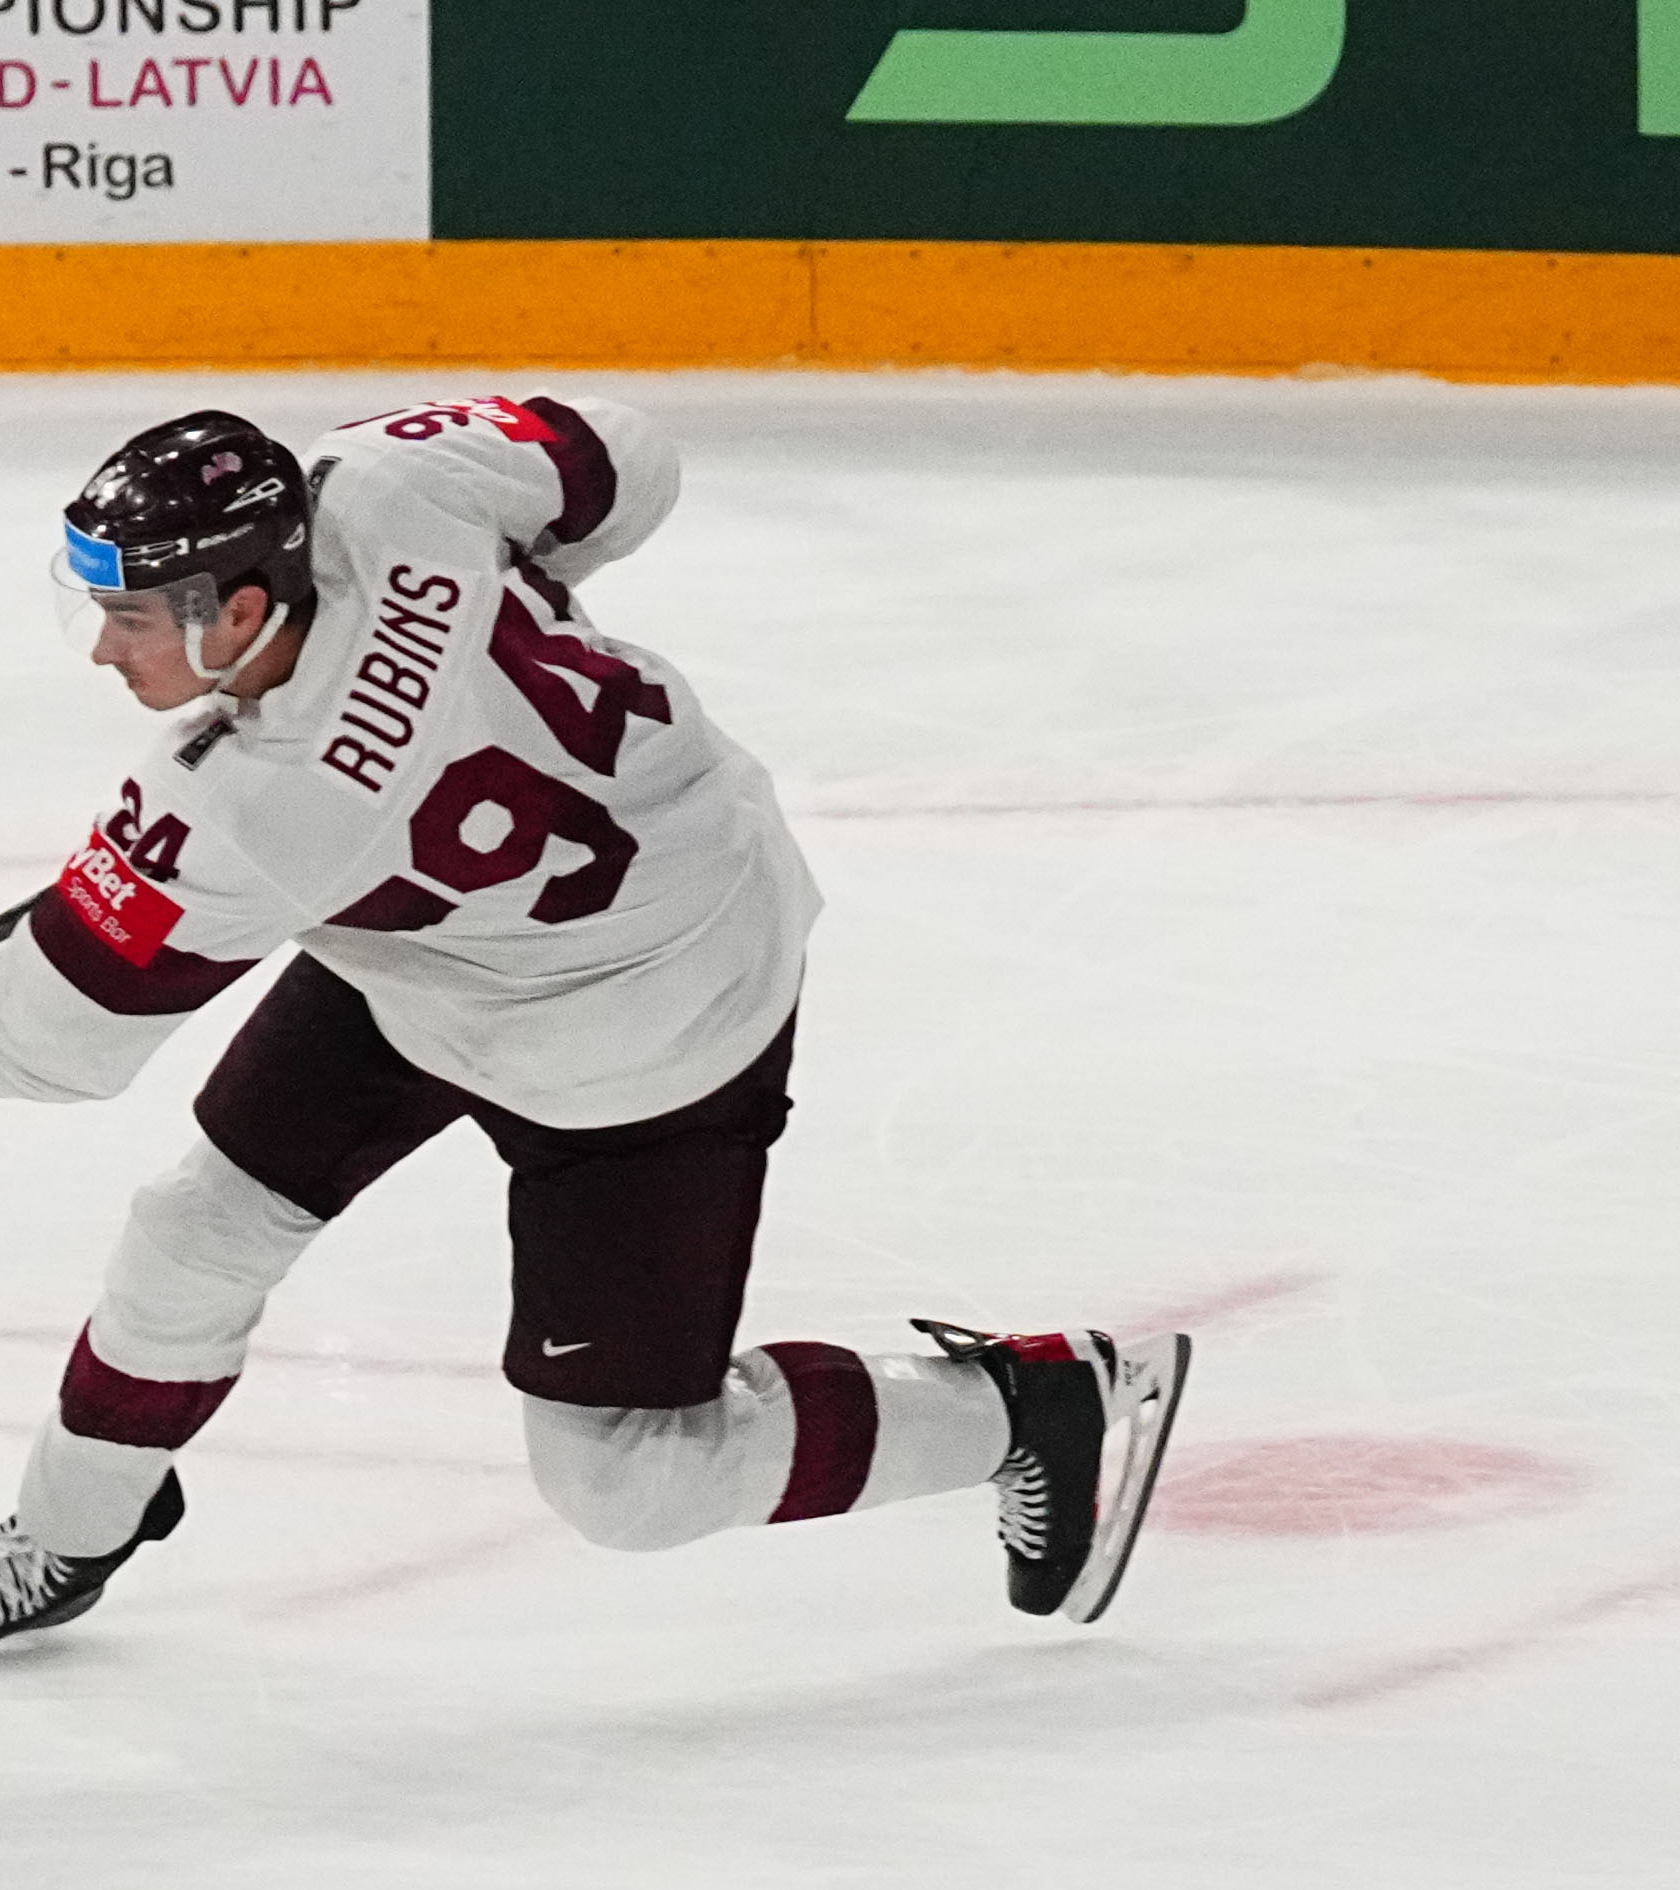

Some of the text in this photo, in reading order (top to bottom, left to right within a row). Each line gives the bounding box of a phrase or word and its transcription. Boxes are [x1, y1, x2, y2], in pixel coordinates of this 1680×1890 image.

[41, 142, 176, 200] Riga
[320, 563, 461, 794] RUBINS
[409, 585, 673, 925] 94
